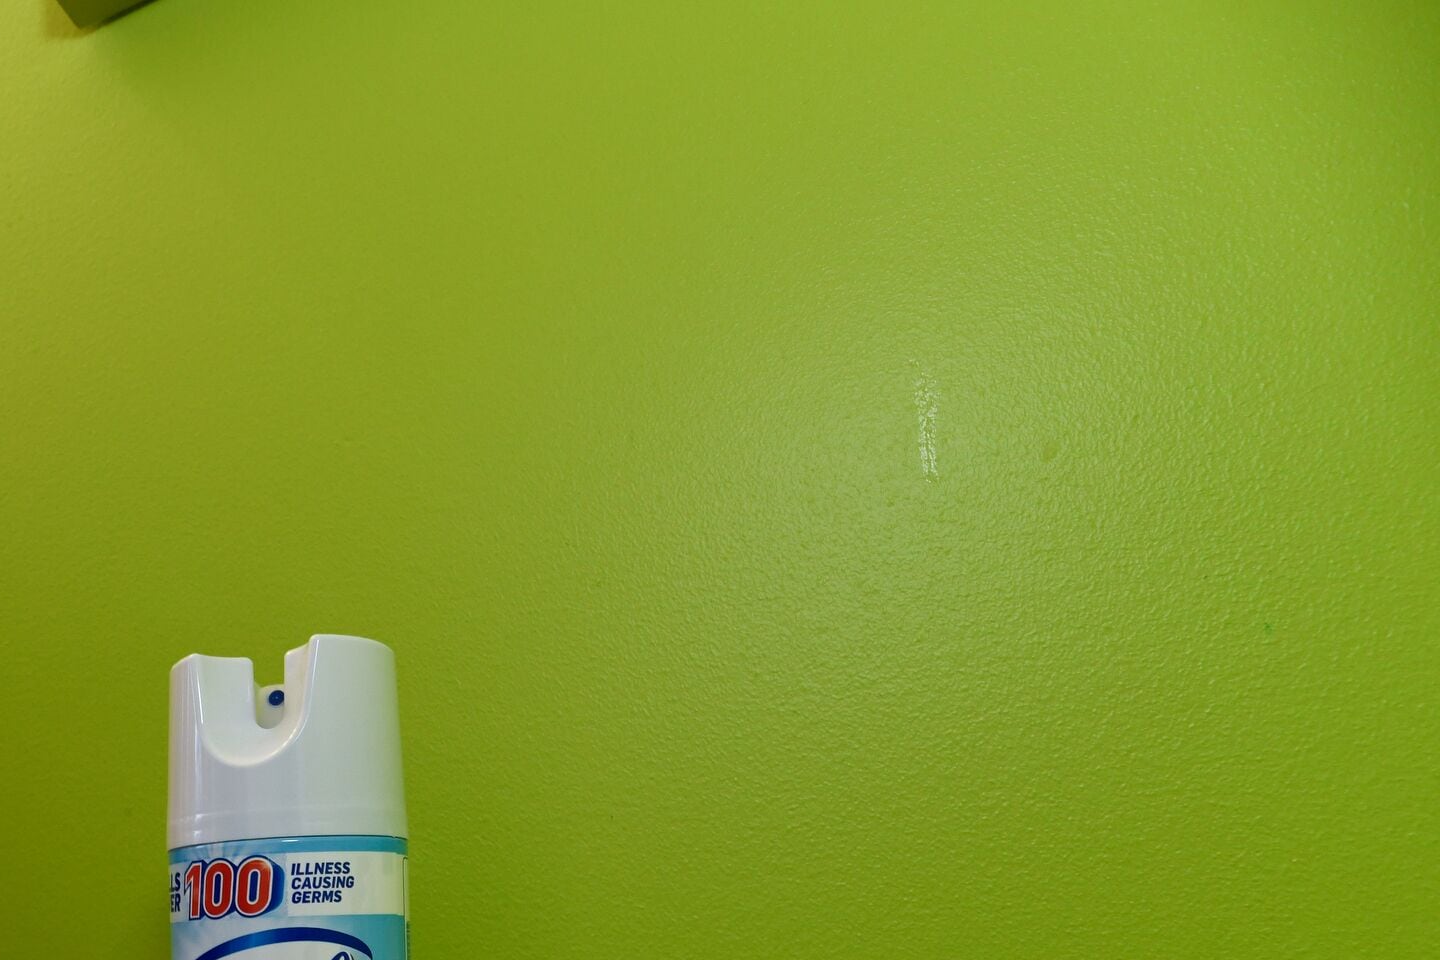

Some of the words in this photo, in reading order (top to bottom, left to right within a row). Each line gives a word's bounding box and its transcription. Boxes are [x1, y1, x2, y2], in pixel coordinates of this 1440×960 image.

[291, 861, 351, 876] ILLNESS
[184, 856, 285, 921] 100
[291, 876, 355, 890] CAUSING
[291, 890, 342, 904] GERMS
